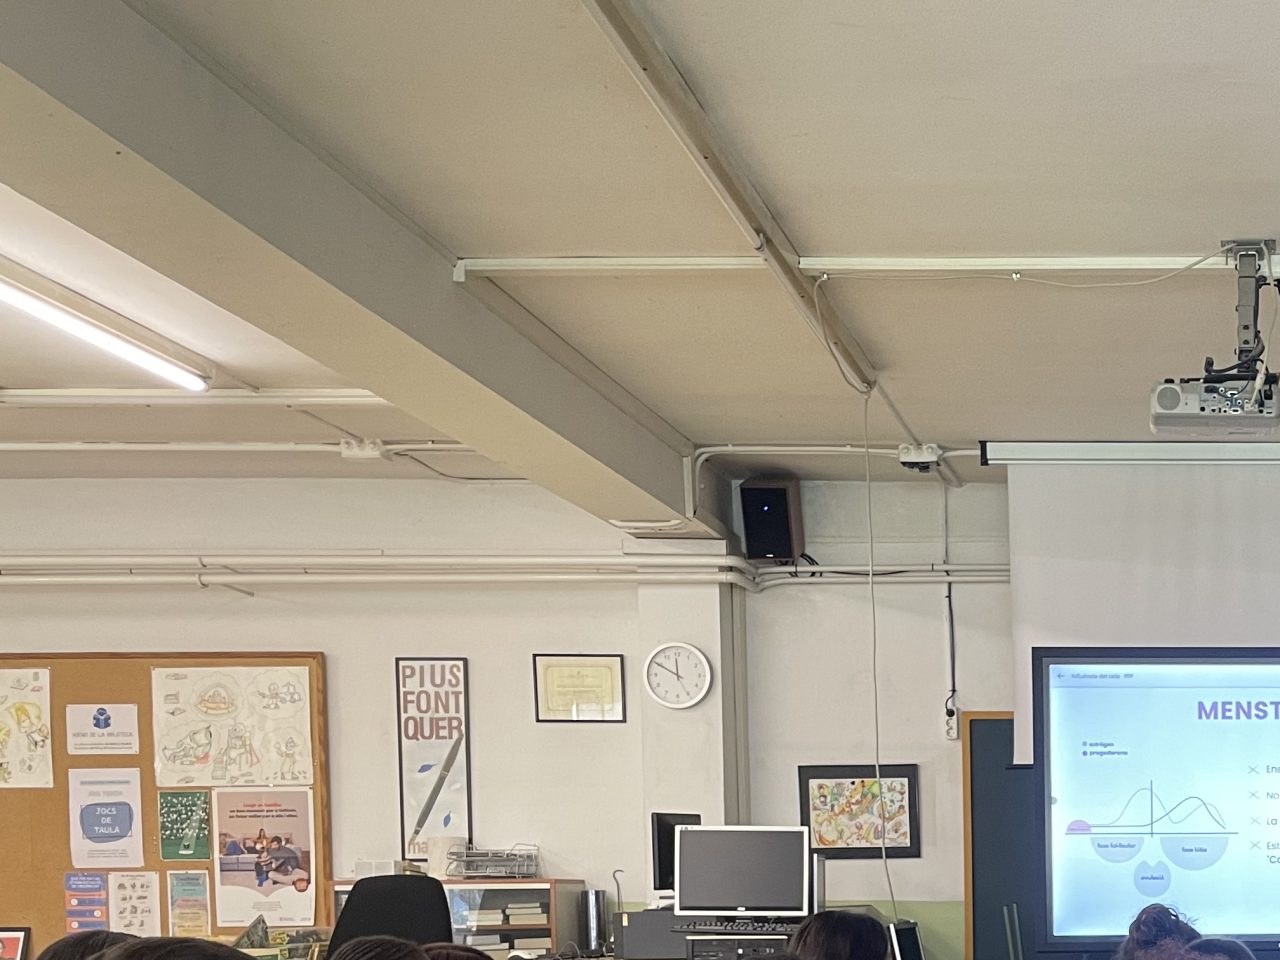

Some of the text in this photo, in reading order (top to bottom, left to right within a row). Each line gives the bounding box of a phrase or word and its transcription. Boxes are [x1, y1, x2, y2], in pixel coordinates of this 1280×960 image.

[401, 664, 461, 688] PIUS
[402, 690, 463, 714] FONT
[403, 716, 464, 741] QUER
[95, 807, 117, 815] JOCS
[101, 816, 113, 824] DE
[1266, 817, 1277, 825] La
[94, 826, 120, 834] TAULA
